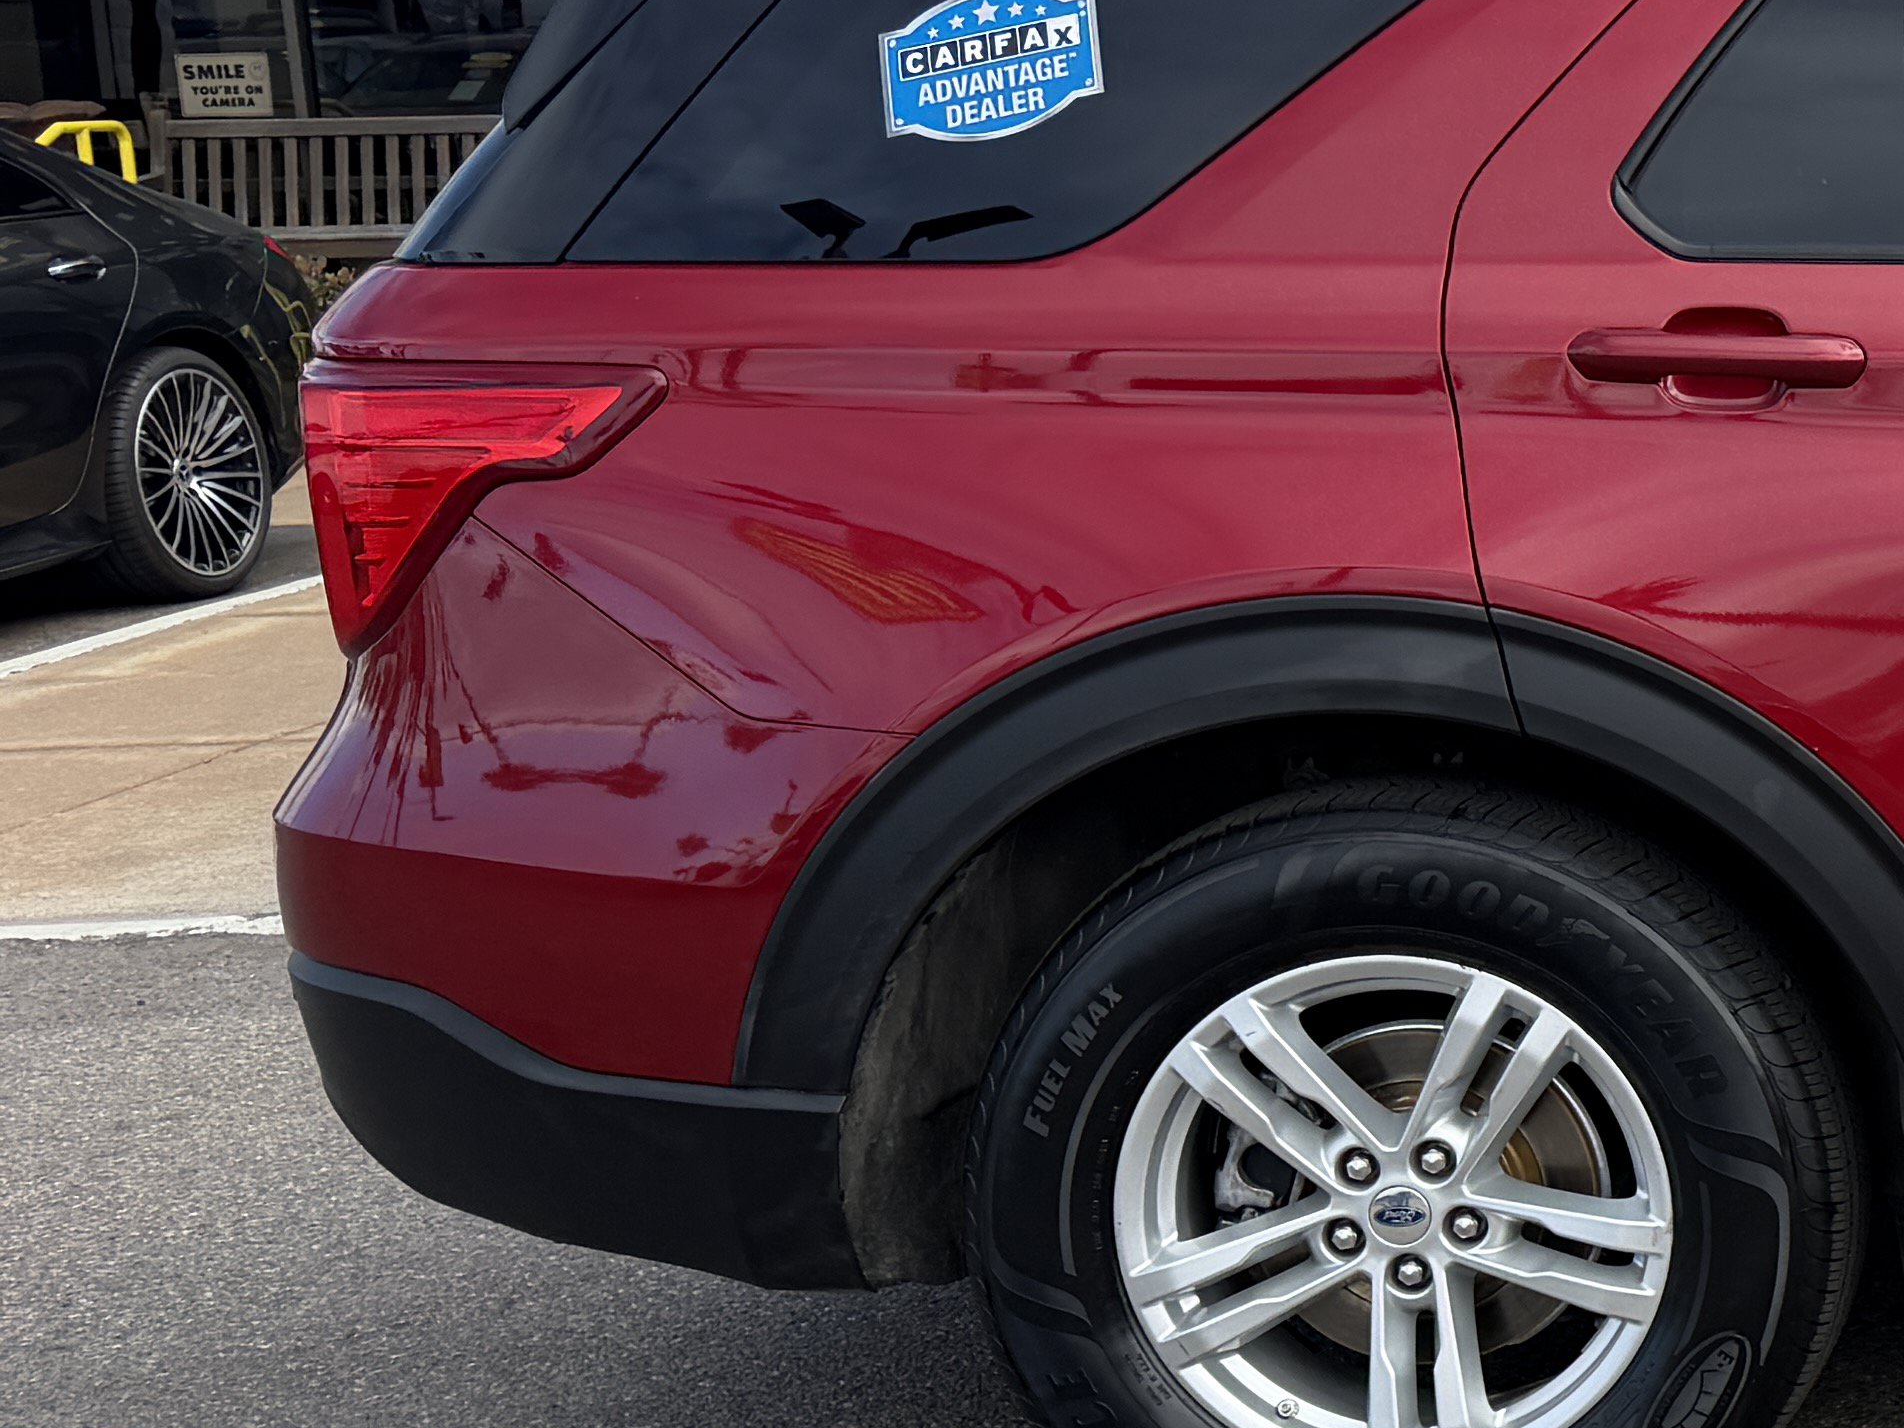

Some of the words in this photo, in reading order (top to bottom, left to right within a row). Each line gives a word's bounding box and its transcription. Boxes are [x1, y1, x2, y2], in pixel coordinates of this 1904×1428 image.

[905, 25, 1074, 74] CARFAX
[182, 64, 245, 80] SMILE
[191, 85, 240, 96] YOU'RE
[245, 85, 264, 95] ON
[202, 97, 256, 108] CAMERA
[945, 87, 1046, 129] DEALER
[1022, 1058, 1072, 1139] FUEL
[1060, 982, 1124, 1058] MAX
